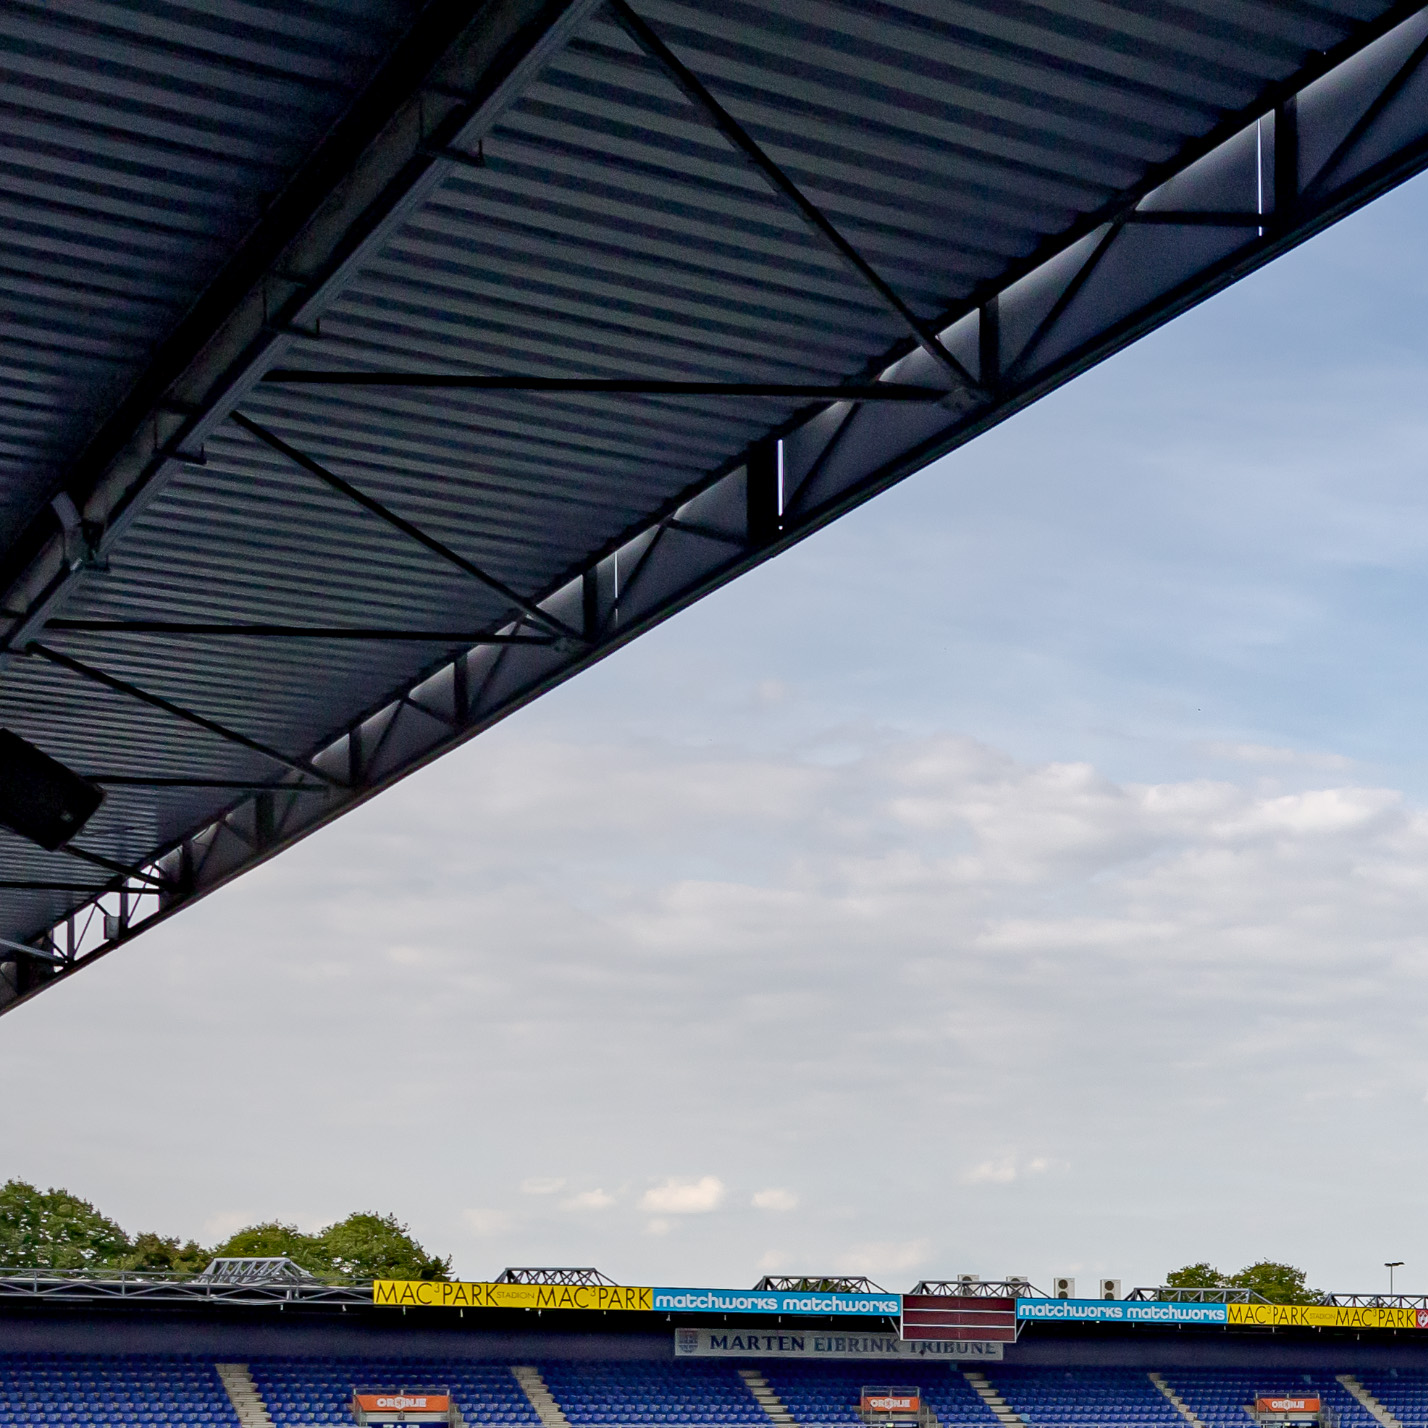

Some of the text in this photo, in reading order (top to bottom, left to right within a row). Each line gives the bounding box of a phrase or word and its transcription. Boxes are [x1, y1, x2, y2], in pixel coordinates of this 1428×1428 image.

[497, 1291, 534, 1299] STADION
[654, 1292, 898, 1313] matchworks matchworks
[1019, 1303, 1225, 1321] matchworks matchworks
[709, 1334, 997, 1355] MARTEN EIBRINK TRIBUNE
